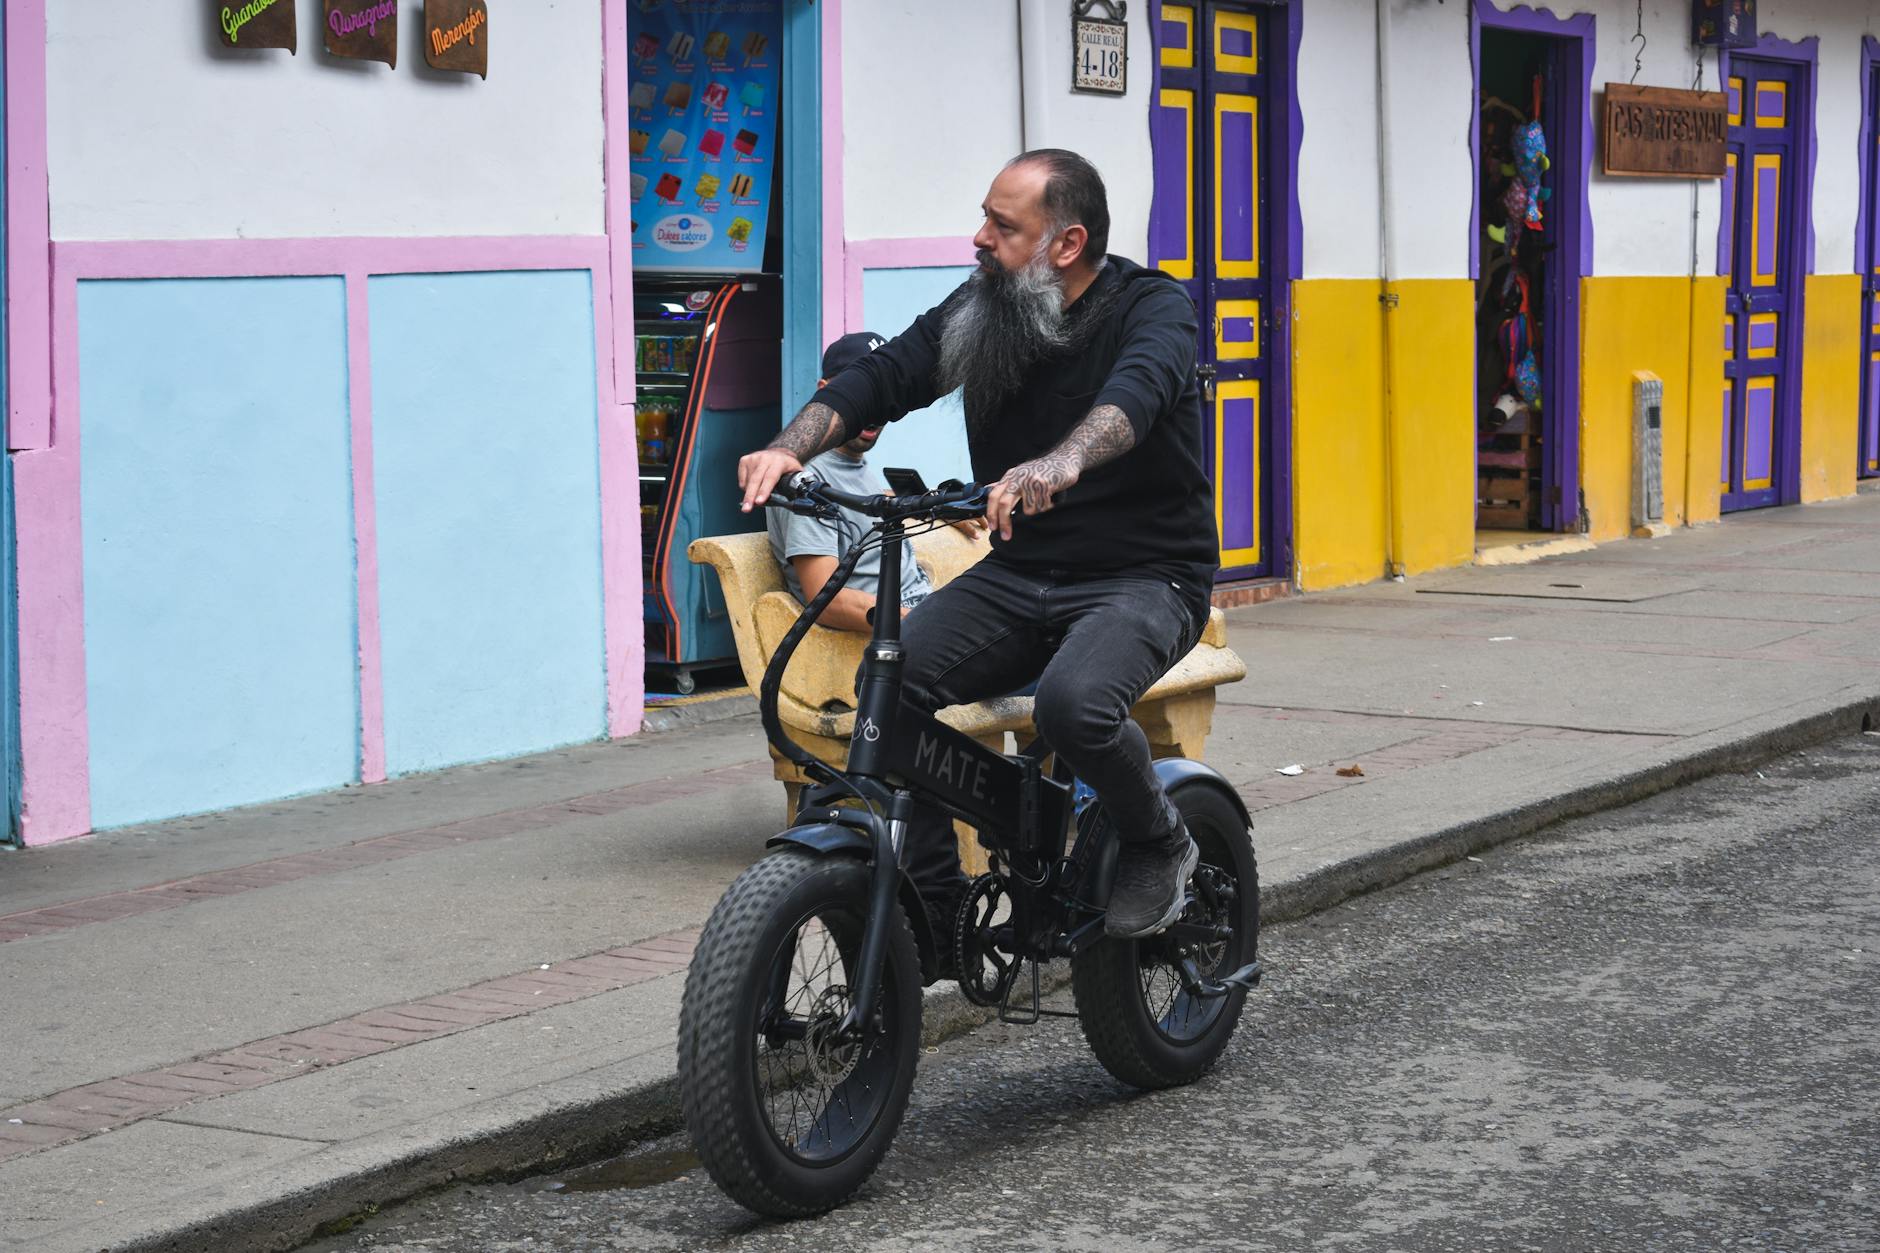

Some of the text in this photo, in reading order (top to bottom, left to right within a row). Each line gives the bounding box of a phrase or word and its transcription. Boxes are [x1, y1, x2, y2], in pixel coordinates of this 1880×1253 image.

[432, 8, 486, 56] Merengón
[1081, 32, 1119, 47] CALLE REAL
